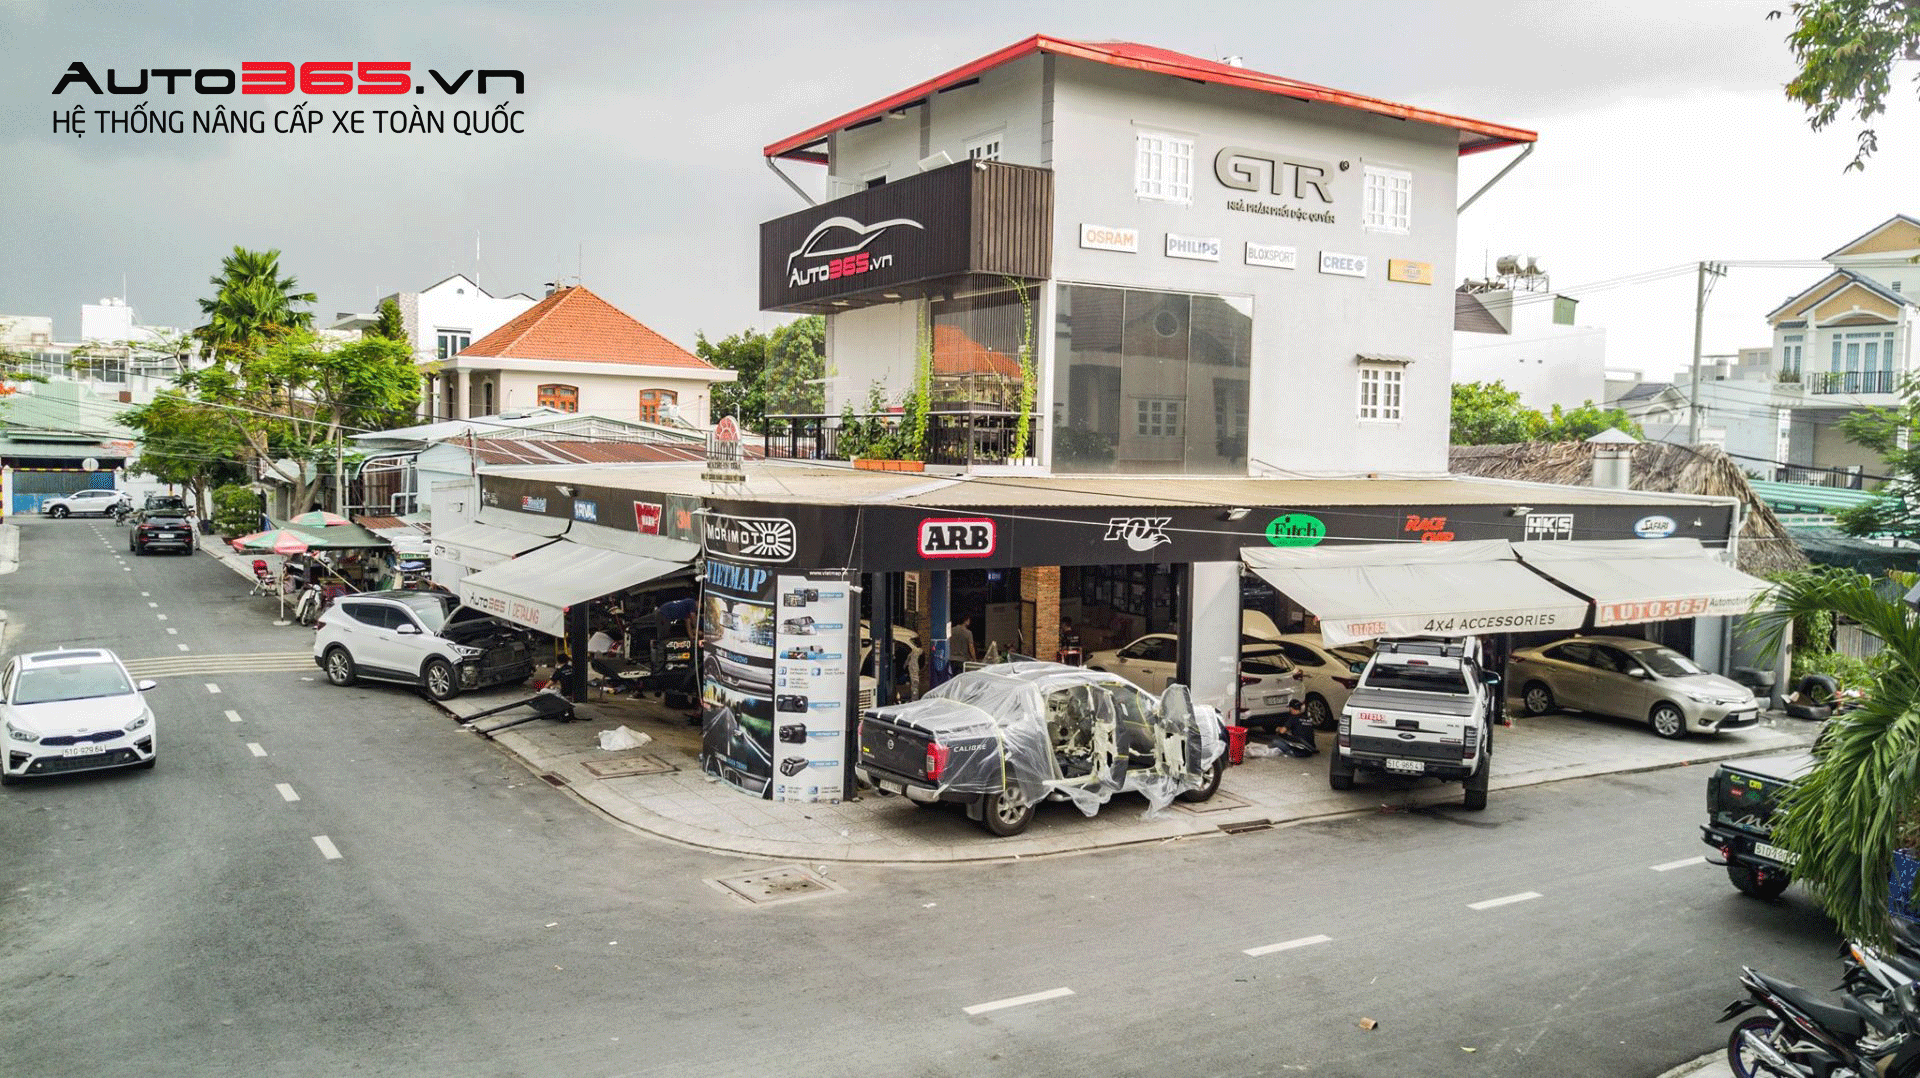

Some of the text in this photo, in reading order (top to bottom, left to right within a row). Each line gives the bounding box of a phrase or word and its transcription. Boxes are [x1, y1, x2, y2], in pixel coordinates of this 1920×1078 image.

[1213, 145, 1335, 204] GTR
[1086, 229, 1134, 246] OSRAM
[1168, 238, 1218, 256] PHILIPS
[1248, 247, 1295, 264] BLOXSPORT
[1323, 255, 1354, 271] CREE
[1104, 517, 1172, 551] FOX
[1273, 516, 1317, 539] Fitch
[1527, 517, 1572, 534] HKS
[924, 526, 990, 551] ARB
[707, 560, 767, 592] VIETMAP
[1601, 598, 1708, 622] AUTO365
[1459, 614, 1556, 630] ACCESSORIES
